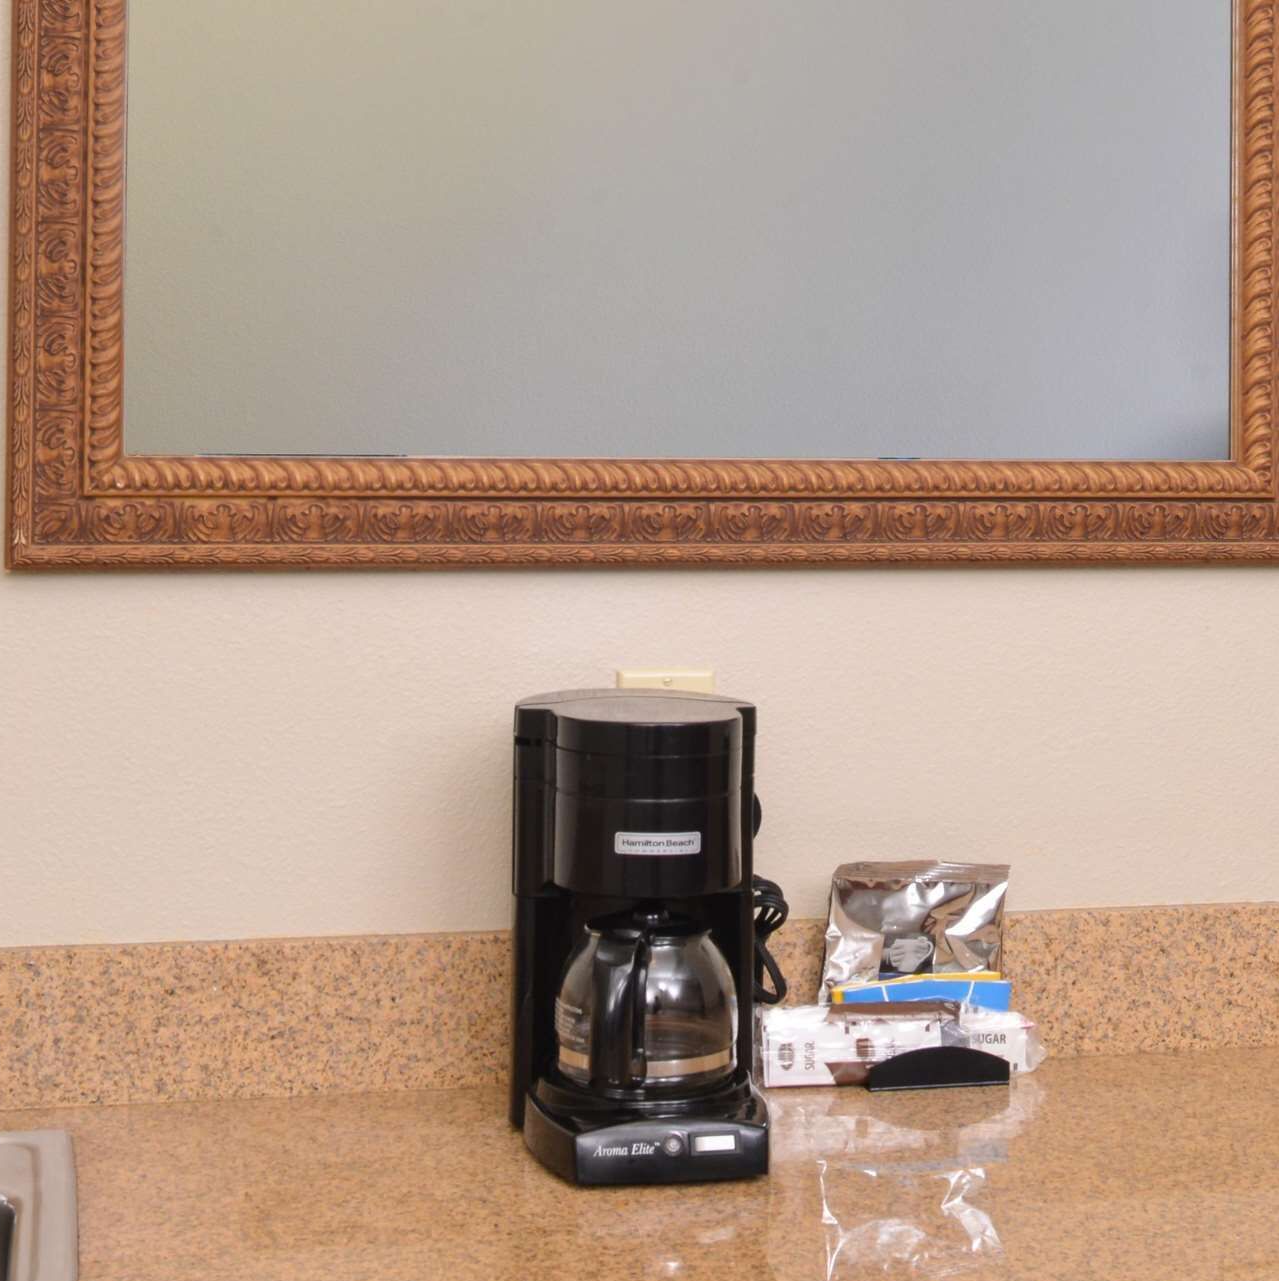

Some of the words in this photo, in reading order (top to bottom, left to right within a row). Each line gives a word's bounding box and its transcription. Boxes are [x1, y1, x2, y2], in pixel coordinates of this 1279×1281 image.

[622, 838, 665, 848] Hamilton
[666, 838, 695, 848] Beach
[804, 1040, 816, 1072] SUGAR
[593, 1144, 629, 1158] Aroma
